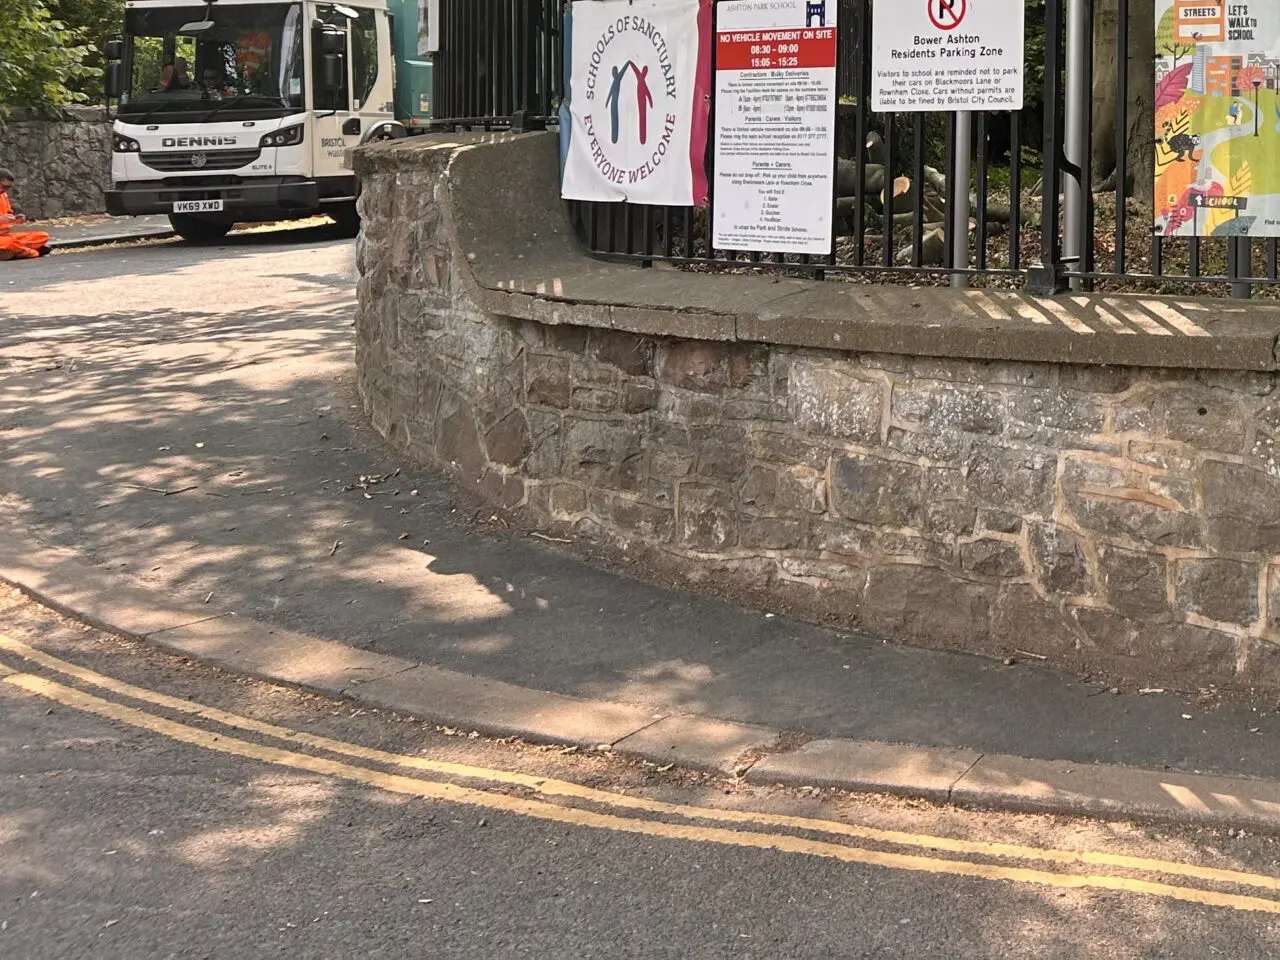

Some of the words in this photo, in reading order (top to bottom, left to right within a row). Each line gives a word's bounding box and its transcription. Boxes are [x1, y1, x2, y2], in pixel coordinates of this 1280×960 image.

[726, 3, 753, 12] ASHTON
[754, 2, 769, 10] PARK
[770, 1, 797, 10] SCHOOL
[1228, 5, 1248, 16] LET'S
[1183, 8, 1216, 17] STREETS
[1228, 17, 1249, 28] WALK
[1250, 18, 1258, 27] TO
[720, 34, 731, 43] NO
[732, 33, 761, 42] VEHICLE
[762, 31, 801, 41] MOVEMENT
[803, 30, 814, 39] ON
[815, 29, 832, 39] SITE
[914, 35, 943, 45] Bower
[946, 34, 980, 44] Ashton
[1228, 29, 1255, 40] SCHOOL
[750, 44, 771, 55] 08:30
[777, 43, 799, 54] 09:00
[891, 49, 936, 59] Residents
[940, 47, 976, 58] Parking
[980, 46, 1003, 56] Zone
[586, 24, 615, 100] SCHOOLS
[616, 15, 630, 34] OF
[631, 15, 677, 100] SANCTUARY
[777, 57, 798, 67] 15:25
[877, 70, 900, 78] Visitors
[911, 69, 932, 77] school
[947, 68, 976, 76] reminded
[993, 67, 1000, 75] to
[1002, 67, 1018, 76] park
[935, 77, 974, 86] Blackmoors
[976, 77, 992, 85] Lane
[932, 87, 948, 95] Cars
[950, 86, 975, 94] without
[977, 86, 1002, 95] permits
[908, 97, 916, 105] be
[918, 96, 935, 104] fined
[937, 96, 945, 106] by
[947, 95, 969, 104] Bristol
[971, 95, 985, 105] City
[161, 135, 237, 148] DENNIS
[321, 137, 346, 147] BRISTOL
[584, 113, 626, 184] EVERYONE
[628, 113, 676, 184] WELCOME
[177, 201, 200, 212] VK69
